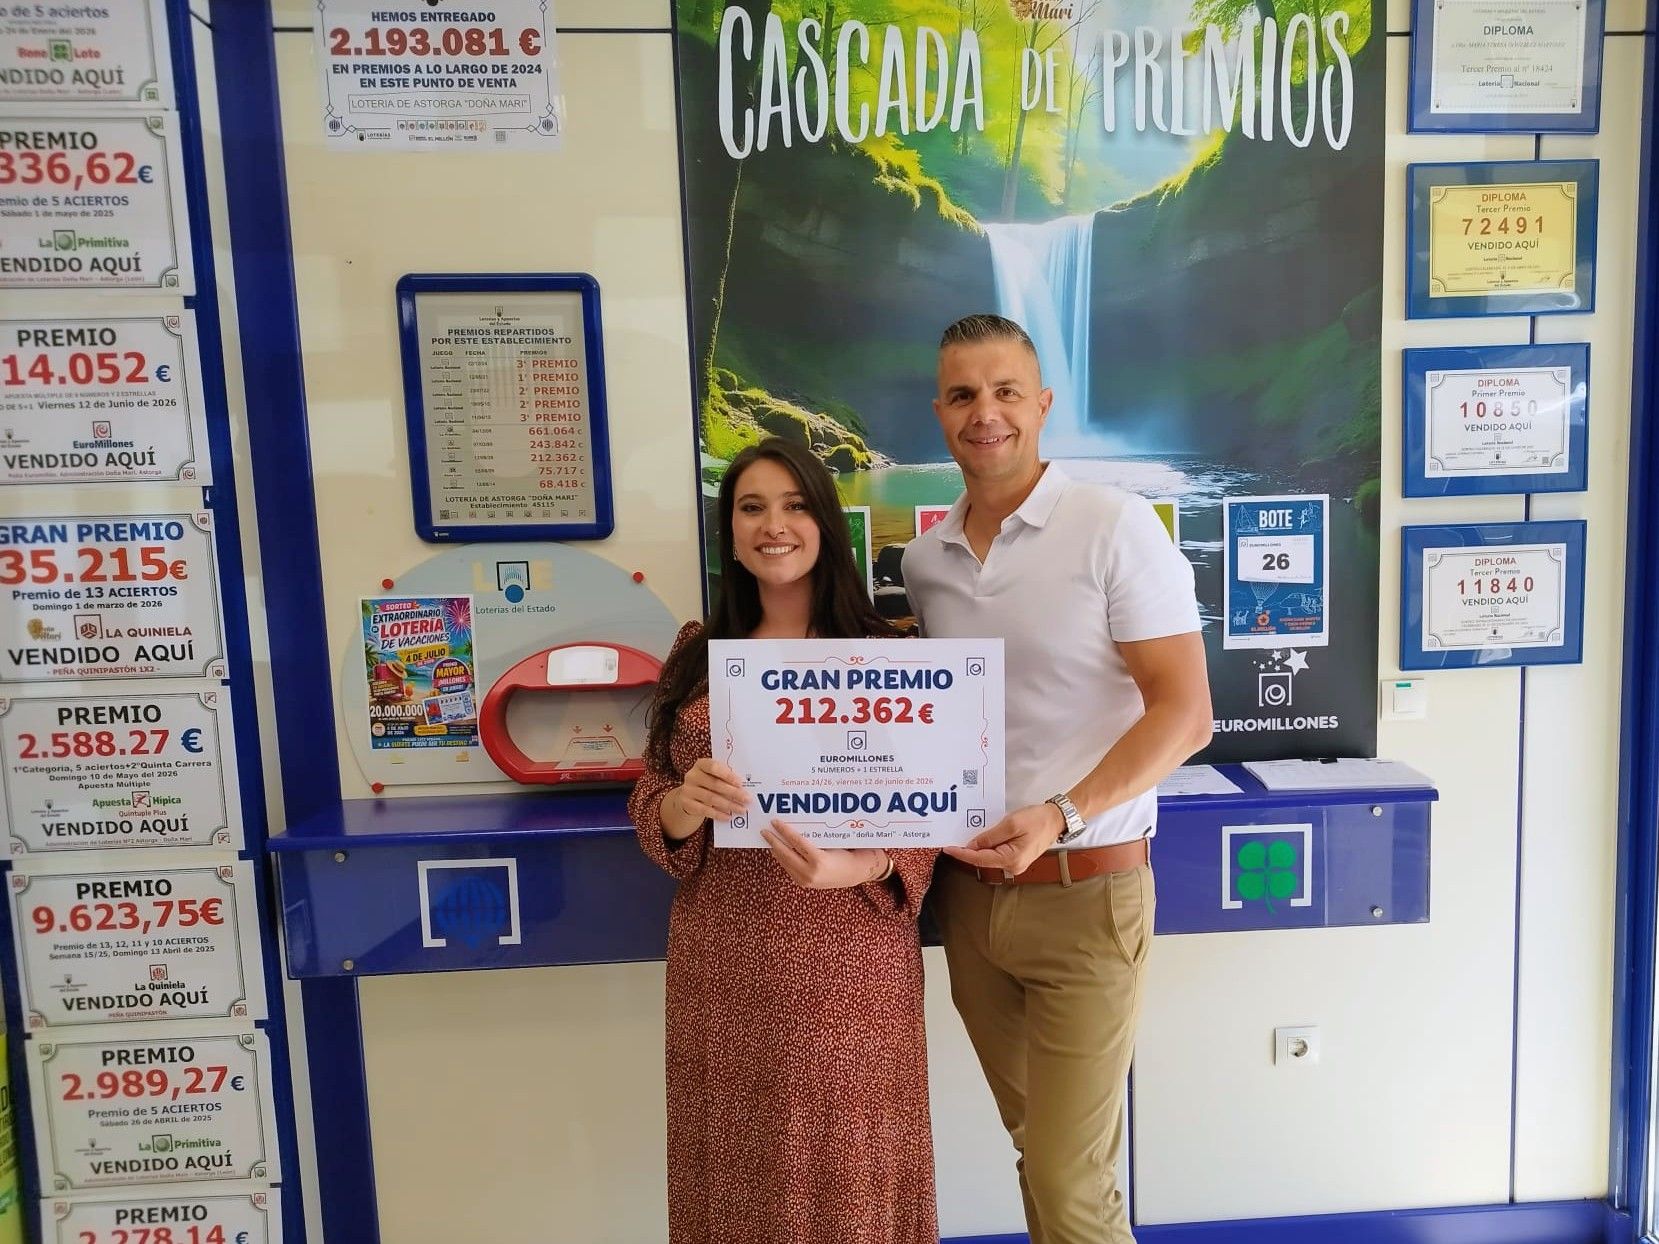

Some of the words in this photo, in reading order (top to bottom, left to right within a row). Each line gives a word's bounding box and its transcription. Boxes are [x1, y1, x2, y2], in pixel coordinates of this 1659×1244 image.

[1032, 1, 1073, 19] Mari
[372, 12, 417, 22] HEMOS
[421, 12, 495, 22] ENTREGADO
[1484, 26, 1533, 35] DIPLOMA
[330, 27, 509, 55] 2.193.081
[519, 27, 541, 55] €
[333, 65, 349, 74] EN
[353, 65, 411, 74] PREMIOS
[414, 65, 422, 74] A
[426, 65, 442, 74] LO
[446, 65, 487, 74] LARGO
[491, 65, 507, 74] DE
[512, 65, 542, 74] 2024
[72, 66, 124, 88] AQUÍ
[717, 5, 984, 160] CASCADA
[1021, 46, 1063, 116] DE
[1101, 11, 1354, 150] PREMIOS
[360, 79, 376, 88] EN
[380, 79, 410, 88] ESTE
[414, 79, 454, 88] PUNTO
[458, 79, 474, 88] DE
[479, 79, 517, 88] VENTA
[414, 100, 461, 108] ASTORGA
[0, 131, 97, 150] PREMIO
[32, 196, 47, 206] de
[52, 196, 59, 206] 5
[64, 196, 129, 206] ACIERTOS
[1482, 194, 1526, 202] DIPLOMA
[1477, 205, 1500, 213] Tercer
[78, 238, 129, 248] Primitiva
[1468, 241, 1512, 250] VENDIDO
[1515, 238, 1539, 249] AQUÍ
[90, 252, 141, 275] AQUÍ
[18, 328, 117, 347] PREMIO
[2, 352, 148, 386] 14.052
[155, 365, 171, 382] €
[532, 360, 578, 368] PREMIO
[1478, 379, 1520, 387] DIPLOMA
[38, 401, 75, 409] Viernes
[79, 401, 91, 409] 12
[109, 400, 134, 408] Junio
[153, 399, 177, 407] 2026
[528, 427, 575, 435] 661.064
[73, 440, 134, 448] EuroMillones
[530, 441, 575, 449] 243.842
[4, 453, 98, 469] VENDIDO
[105, 447, 156, 470] AQUÍ
[531, 454, 577, 462] 212.362
[539, 467, 577, 475] 75.717
[540, 480, 578, 488] 68.418
[1259, 510, 1293, 527] BOTE
[0, 525, 67, 544] GRAN
[77, 522, 184, 542] PREMIO
[1262, 553, 1290, 571] 26
[1475, 558, 1516, 566] DIPLOMA
[13, 589, 60, 600] Premio
[65, 588, 81, 599] de
[86, 587, 103, 598] 13
[109, 587, 177, 597] ACIERTOS
[33, 603, 73, 611] Domingo
[141, 600, 162, 608] 2026
[1462, 598, 1503, 606] VENDIDO
[1506, 595, 1528, 604] AQUÍ
[512, 605, 524, 613] del
[527, 604, 555, 613] Estado
[373, 609, 441, 623] EXTRAORDINARIO
[106, 629, 123, 638] LA
[128, 627, 192, 638] QUINIELA
[381, 640, 396, 650] DE
[398, 633, 449, 647] VACACIONES
[8, 646, 119, 665] VENDIDO
[135, 640, 193, 662] AQUÍ
[413, 653, 422, 661] DE
[424, 649, 445, 660] JULIO
[437, 667, 464, 677] MAYOR
[761, 670, 840, 690] GRAN
[848, 669, 953, 690] PREMIO
[58, 705, 161, 726] PREMIO
[371, 704, 422, 717] 20.000.000
[1212, 716, 1338, 732] EUROMILLONES
[18, 729, 170, 759] 2.588.27
[180, 728, 203, 753] €
[818, 764, 855, 773] NÚMEROS
[92, 797, 131, 807] Apuesta
[758, 792, 881, 814] VENDIDO
[888, 785, 958, 817] AQUÍ
[42, 820, 133, 836] VENDIDO
[140, 814, 189, 834] AQUÍ
[824, 831, 850, 839] Astorga
[903, 831, 930, 839] Astorga
[76, 879, 172, 900] PREMIO
[32, 898, 224, 934] 9.623,75€
[53, 943, 84, 951] Premio
[100, 942, 113, 950] 13,
[116, 941, 129, 949] 12,
[166, 937, 208, 945] ACIERTOS
[149, 981, 185, 991] Quiniela
[63, 994, 152, 1011] VENDIDO
[160, 986, 208, 1007] AQUÍ
[102, 1046, 195, 1066] PREMIO
[88, 1107, 130, 1118] Premio
[133, 1107, 147, 1116] de
[151, 1106, 157, 1115] 5
[162, 1102, 222, 1113] ACIERTOS
[174, 1138, 221, 1149] Primitiva
[90, 1158, 178, 1175] VENDIDO
[185, 1151, 233, 1171] AQUÍ
[116, 1205, 207, 1225] PREMIO
